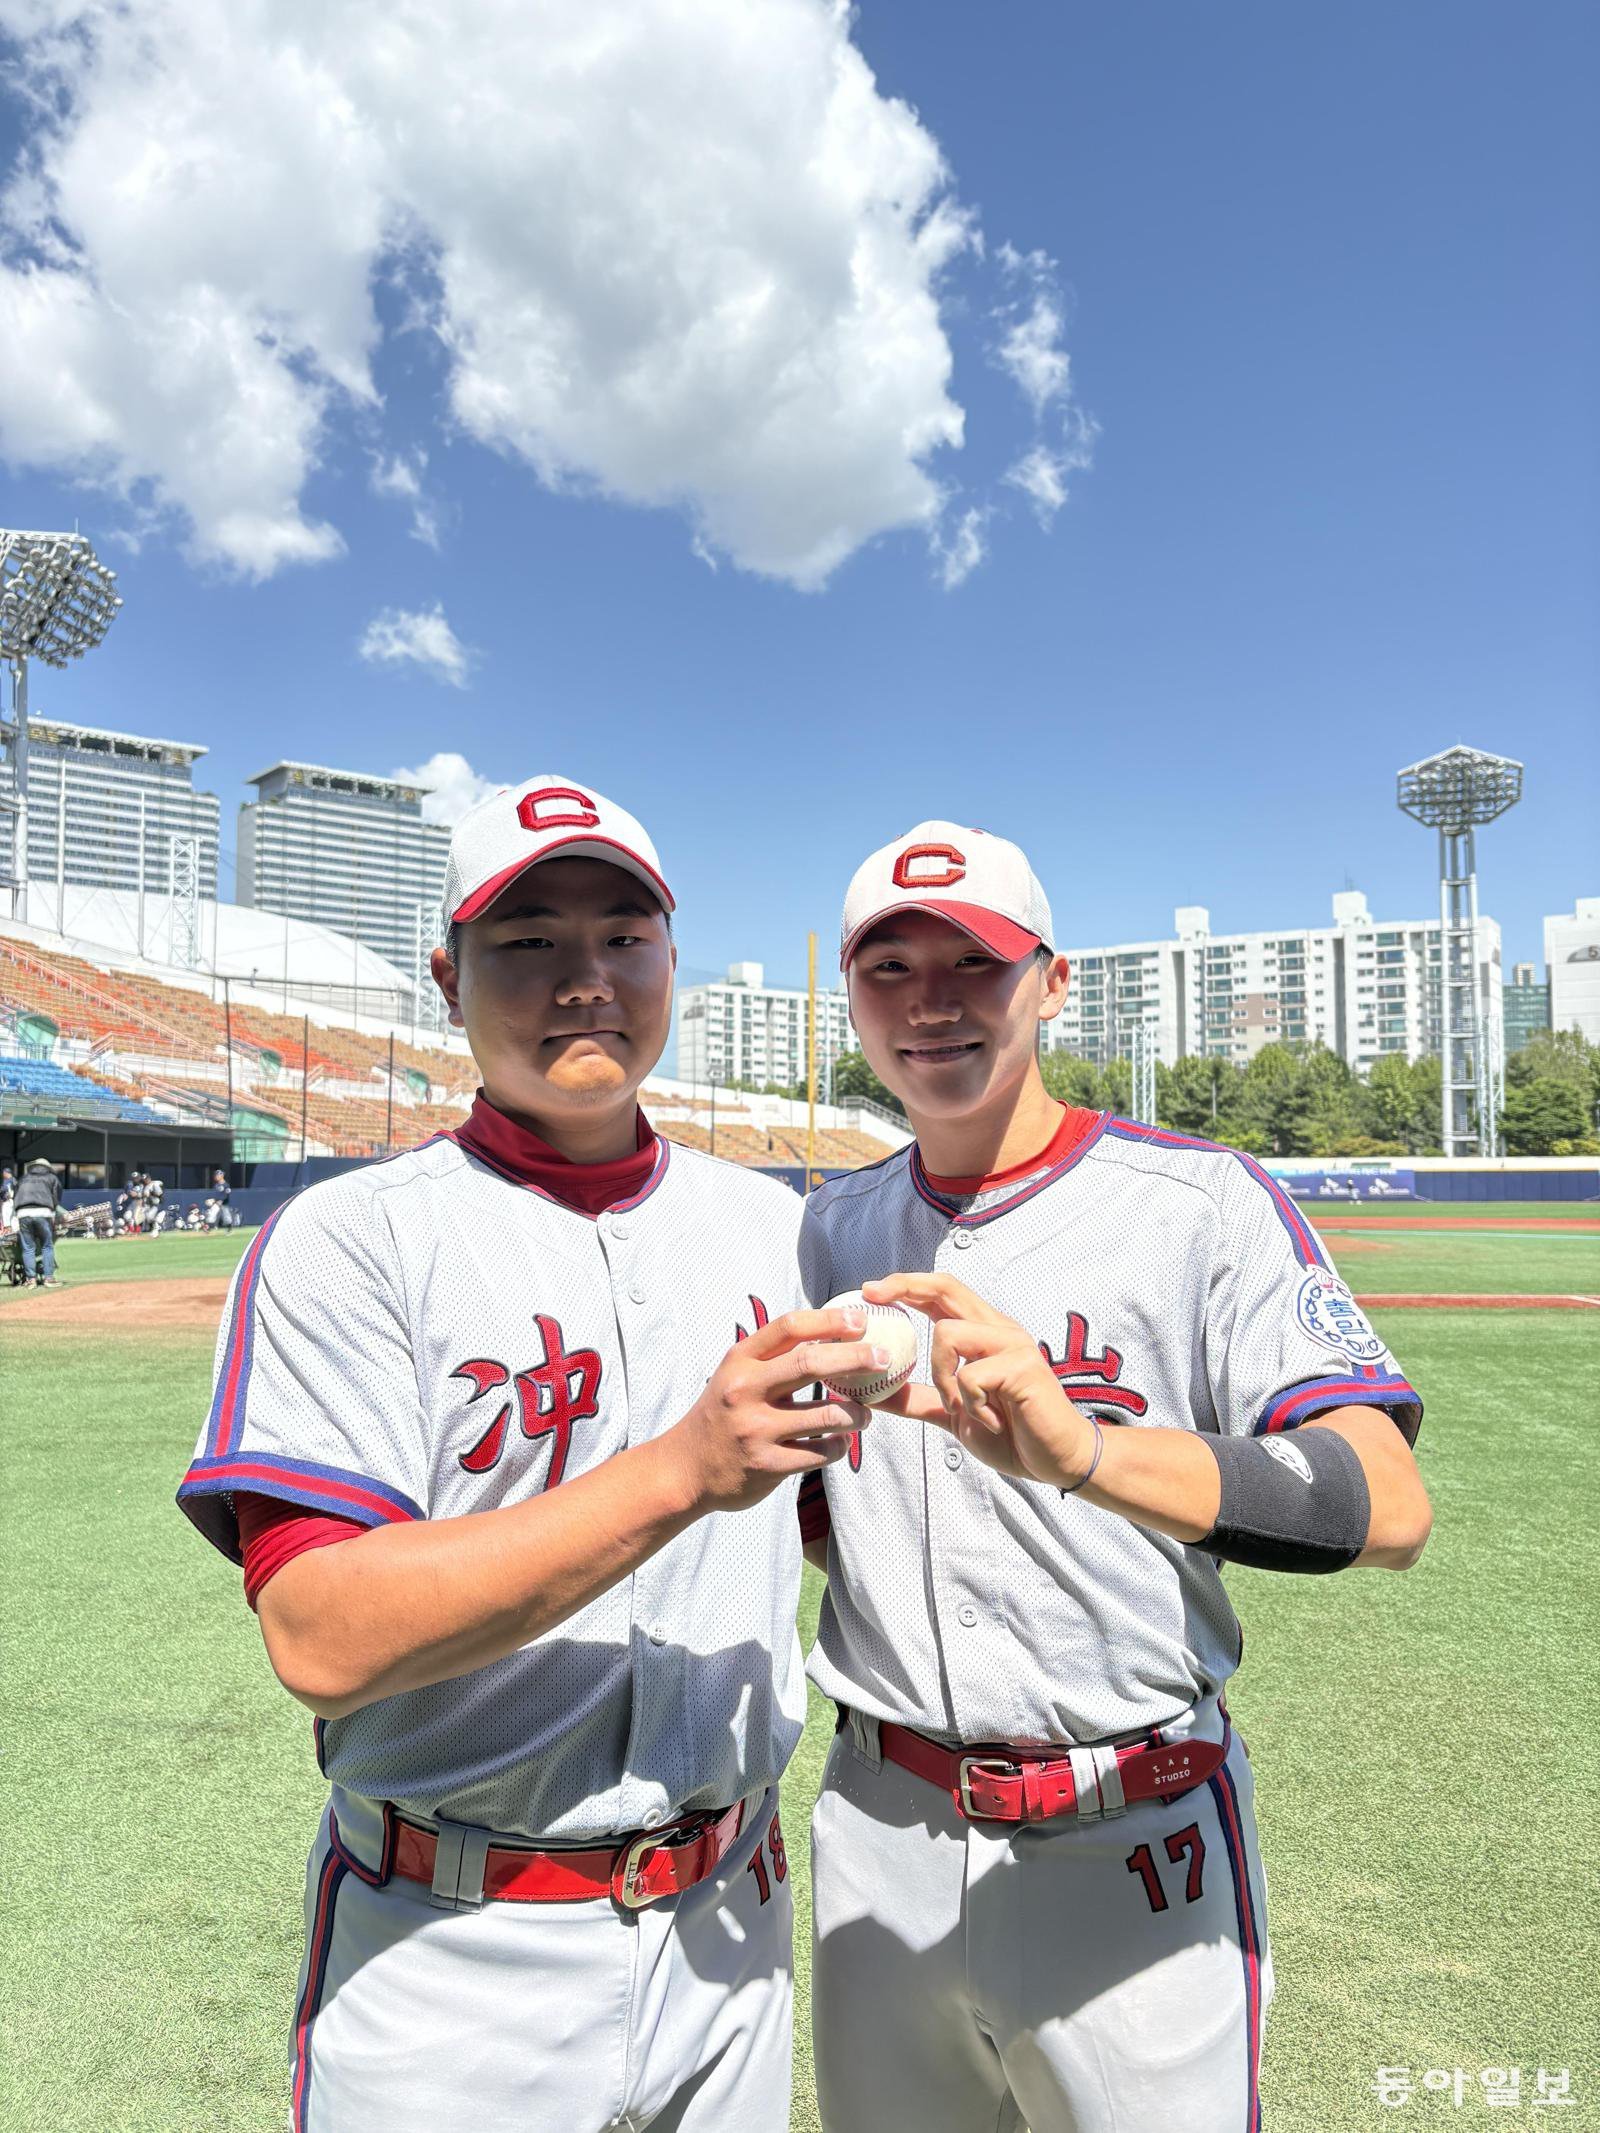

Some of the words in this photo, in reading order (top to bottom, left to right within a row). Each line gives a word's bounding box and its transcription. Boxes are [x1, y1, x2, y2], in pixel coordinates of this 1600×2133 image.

[516, 787, 601, 832] C
[892, 843, 966, 889] C
[1155, 1769, 1190, 1784] STUDIO
[746, 1810, 787, 1906] 18
[1125, 1821, 1206, 1913] 17
